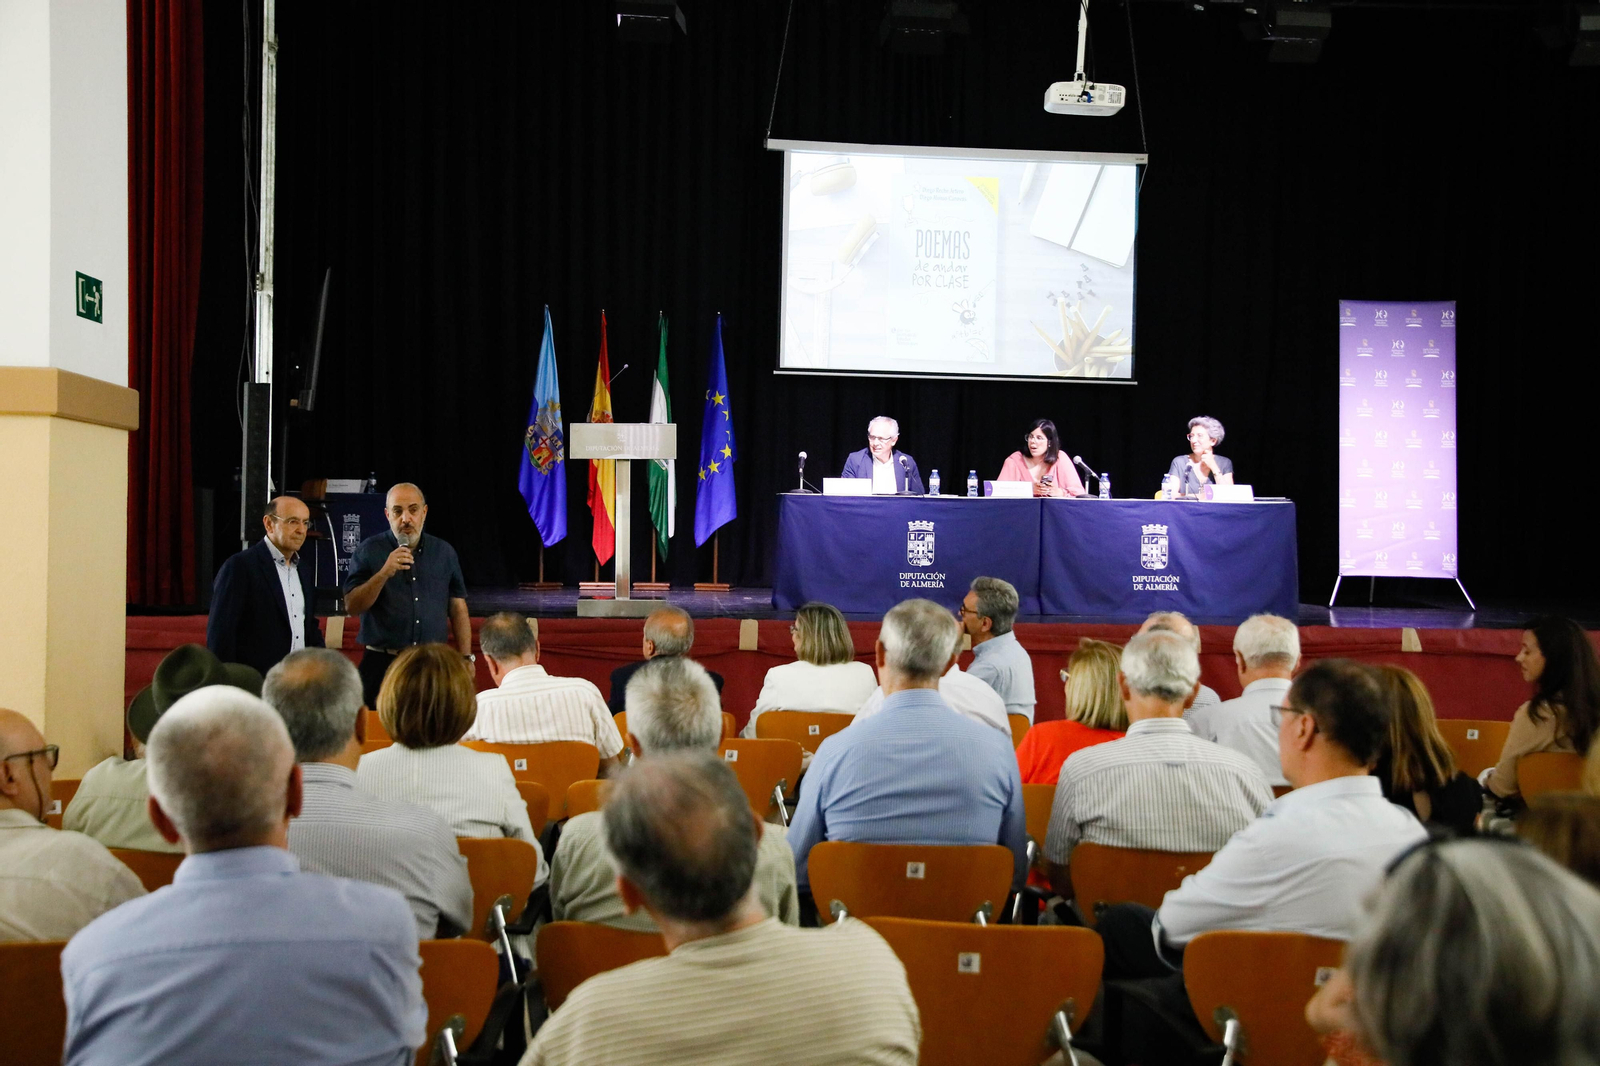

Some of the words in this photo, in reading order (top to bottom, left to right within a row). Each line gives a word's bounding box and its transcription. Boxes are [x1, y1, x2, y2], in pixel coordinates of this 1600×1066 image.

[915, 229, 970, 260] POEMAS
[914, 260, 929, 272] de
[932, 261, 968, 272] andar
[912, 273, 932, 287] POR
[936, 274, 969, 288] CLASE
[899, 571, 946, 580] DIPUTACIÓN
[1132, 574, 1180, 583] DIPUTACIÓN
[911, 580, 944, 588] ALMERÍA
[1145, 582, 1178, 590] ALMERÍA
